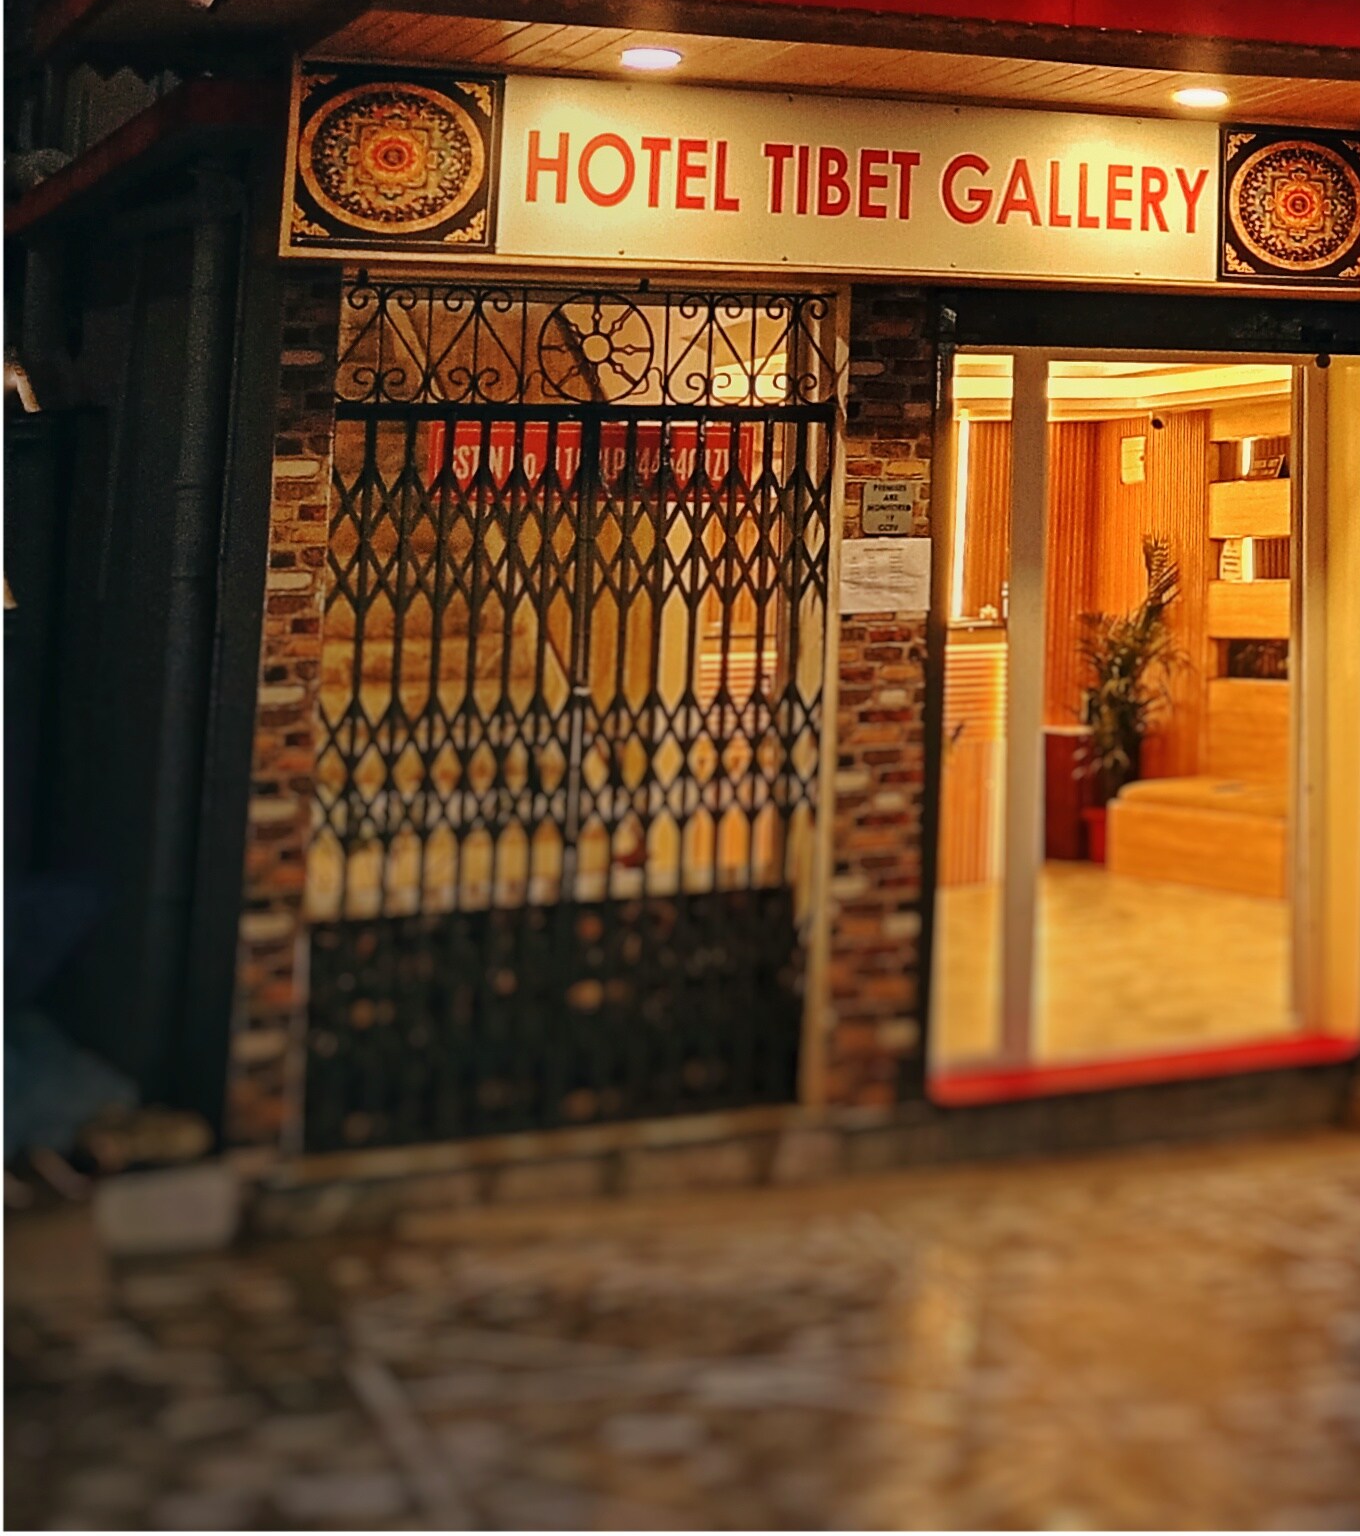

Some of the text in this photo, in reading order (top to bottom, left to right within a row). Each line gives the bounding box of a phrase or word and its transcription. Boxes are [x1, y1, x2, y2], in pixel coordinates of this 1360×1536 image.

[525, 130, 1209, 233] HOTEL TIBET GALLERY
